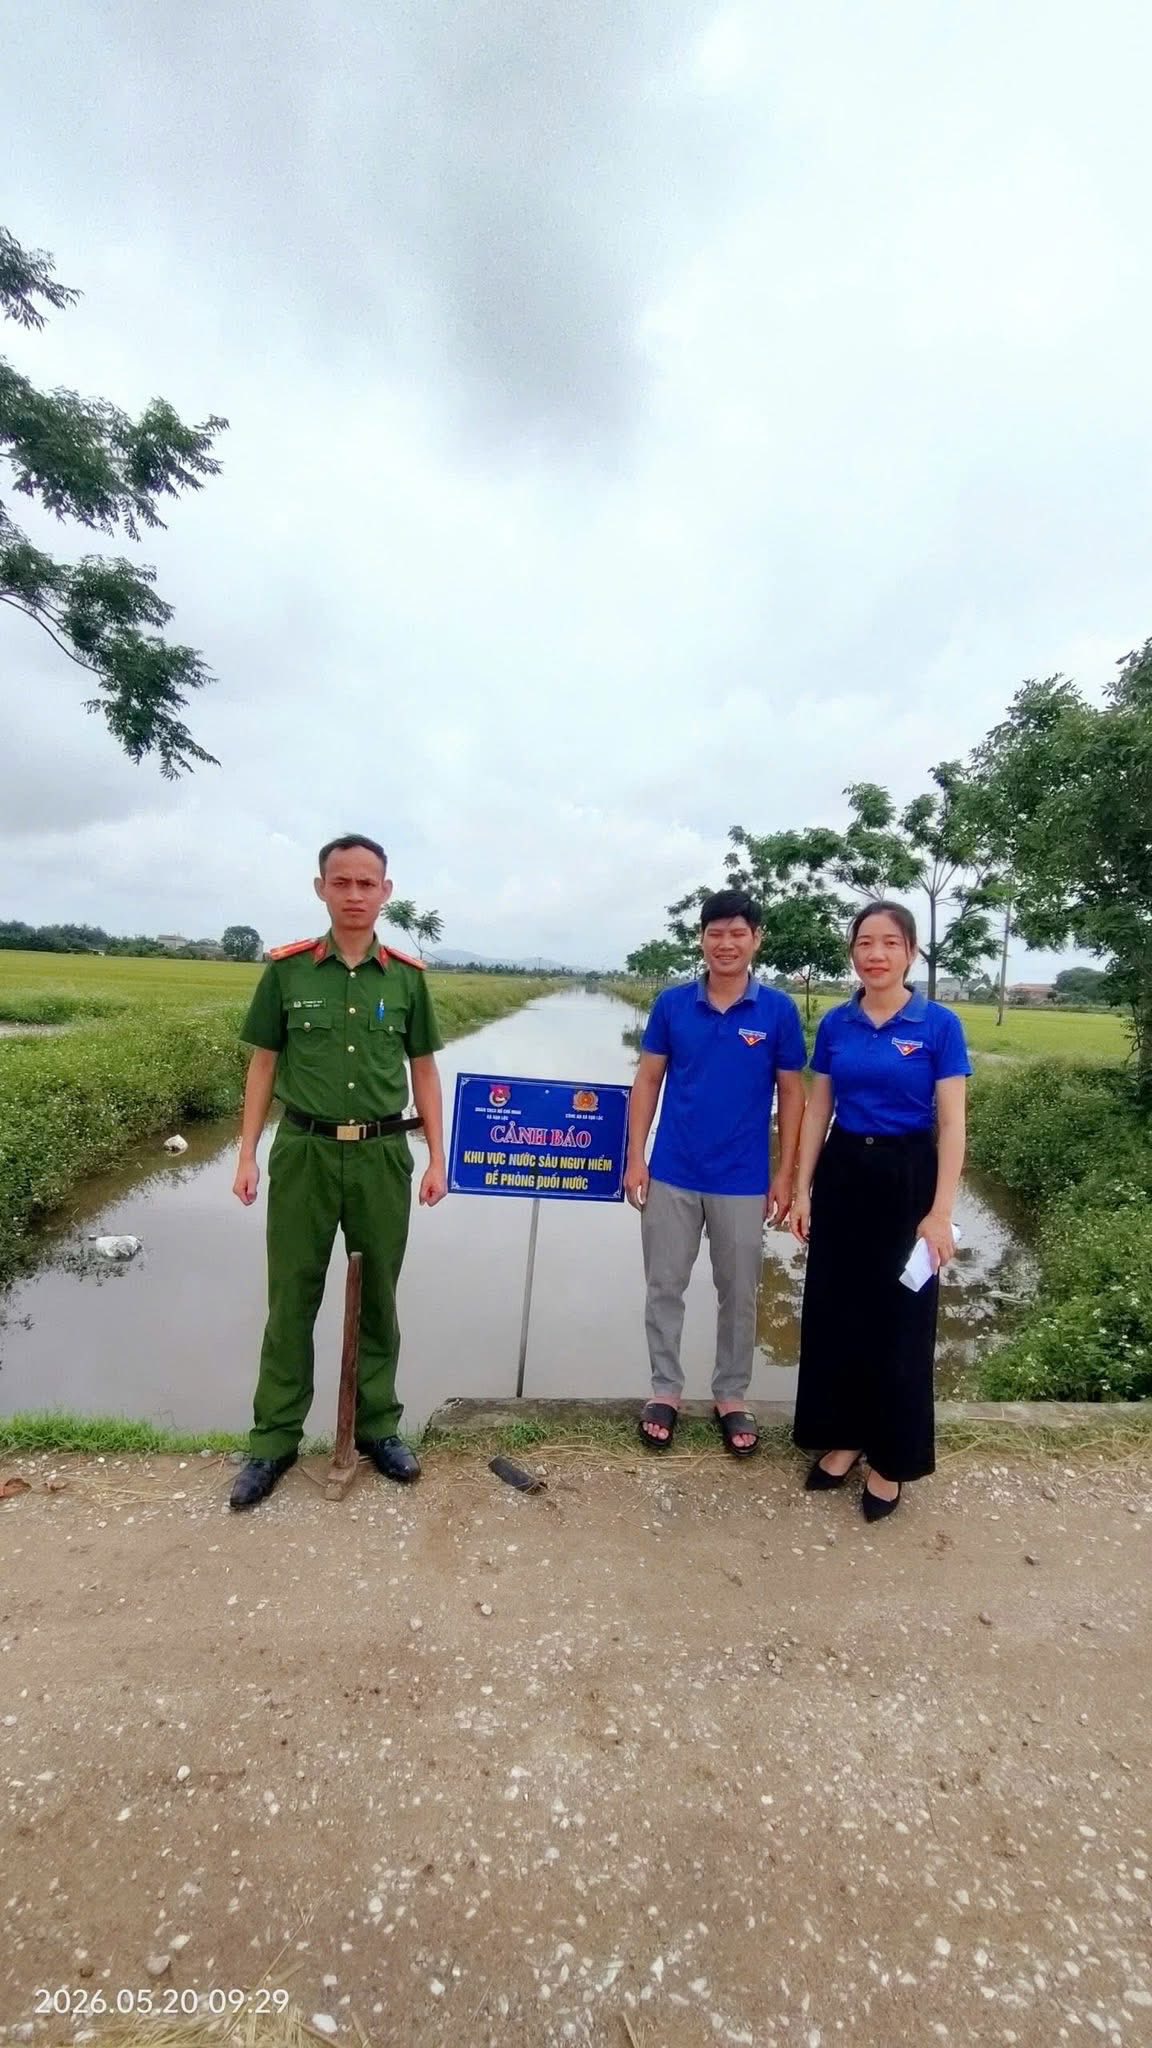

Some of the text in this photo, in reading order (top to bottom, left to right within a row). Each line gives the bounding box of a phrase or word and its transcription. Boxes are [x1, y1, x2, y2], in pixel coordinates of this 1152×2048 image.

[490, 1120, 592, 1148] CẢNH BÁO
[463, 1150, 612, 1172] KHU VỰC NƯỚC SÂU NGUY HIỂM
[500, 1171, 535, 1187] PHÒNG
[561, 1175, 589, 1190] NƯỚC
